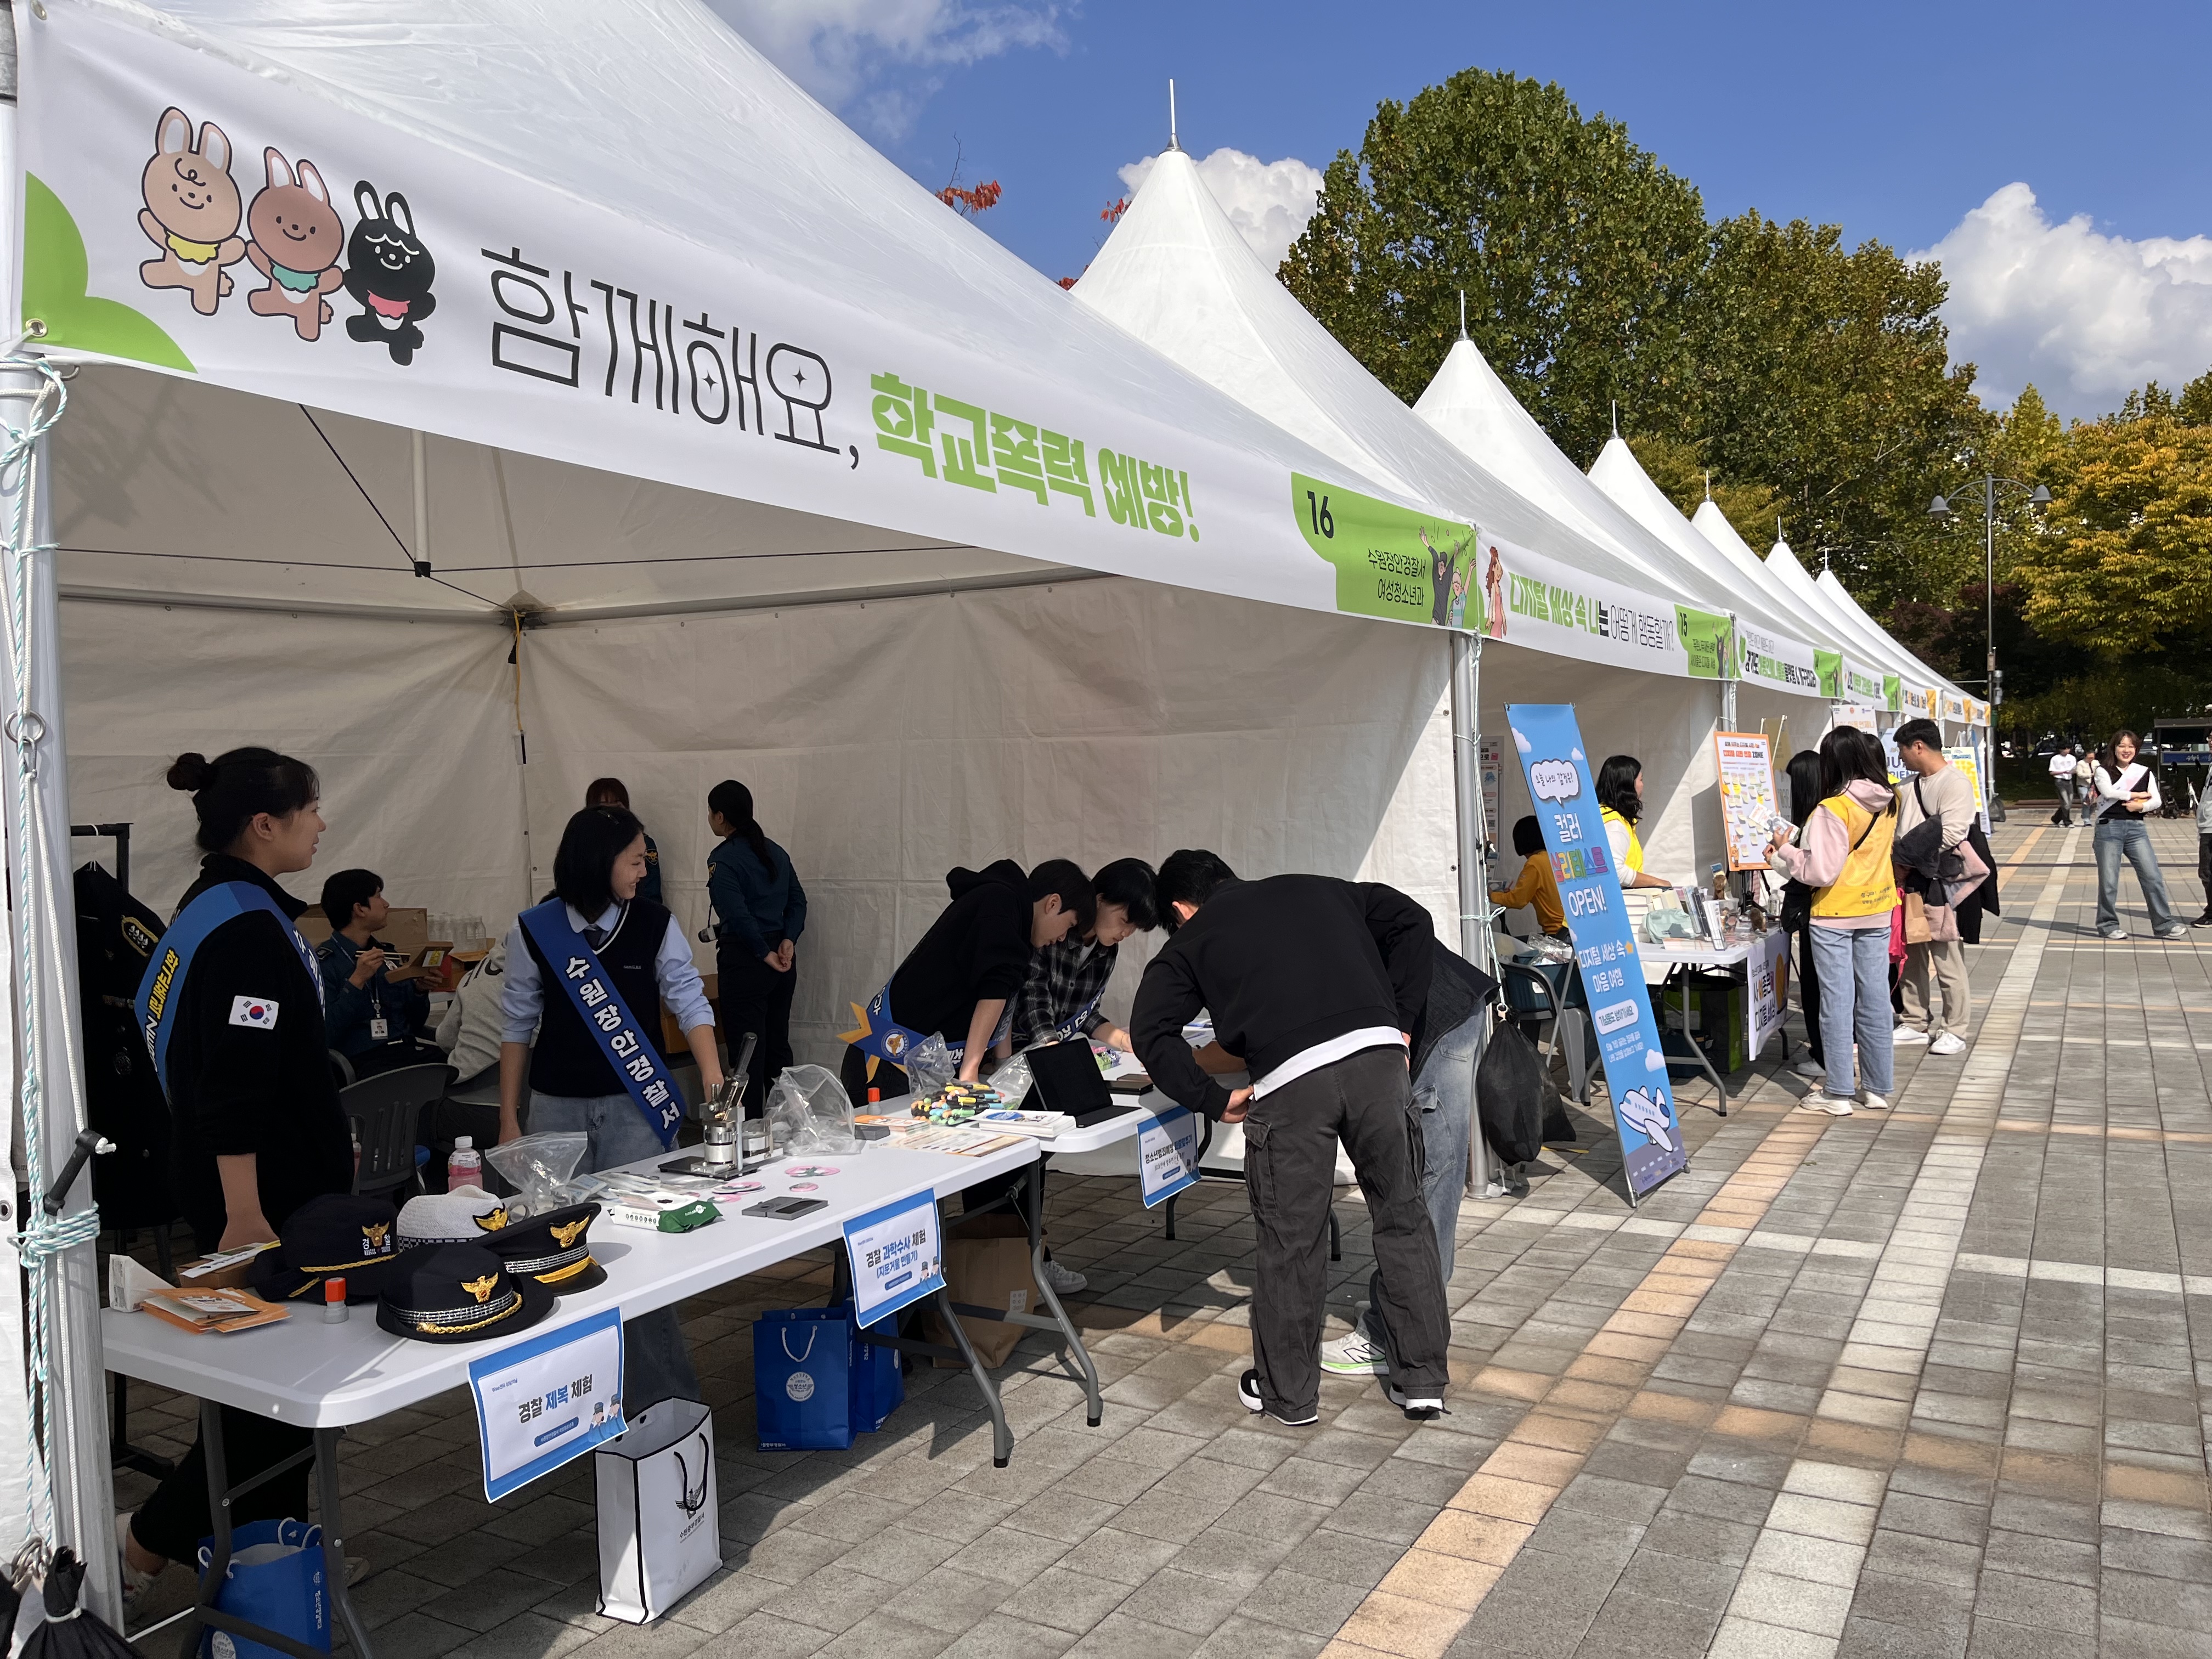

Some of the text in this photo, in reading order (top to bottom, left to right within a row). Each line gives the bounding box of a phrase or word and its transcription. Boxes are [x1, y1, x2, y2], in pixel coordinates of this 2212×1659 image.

[481, 247, 1200, 543] 함께해요, 학교폭력 예방!
[1307, 490, 1334, 539] 16
[1368, 548, 1426, 579] 수원장안경찰서
[1378, 579, 1424, 607] 여성청소년과
[1508, 572, 1674, 651] 디지털 세상 속 나는 어떻게 행동할까?
[1679, 612, 1688, 636] 15
[1536, 772, 1573, 787] 오늘 나의 감정은?
[1554, 812, 1583, 843] 컬러
[1550, 847, 1609, 883] 심리테스트
[1568, 884, 1607, 917] OPEN!
[1578, 939, 1626, 968] 디지털 세상 속
[1592, 968, 1624, 993] 마음 여행
[566, 957, 681, 1130] 수원장안경찰서
[1146, 1142, 1174, 1164] 청소년범죄예방
[866, 1248, 882, 1268] 경찰
[882, 1235, 911, 1261] 과학수사
[912, 1228, 926, 1246] 체험
[877, 1250, 918, 1279] (지문거울 만들기)
[518, 1374, 592, 1424] 경찰 제복 체험
